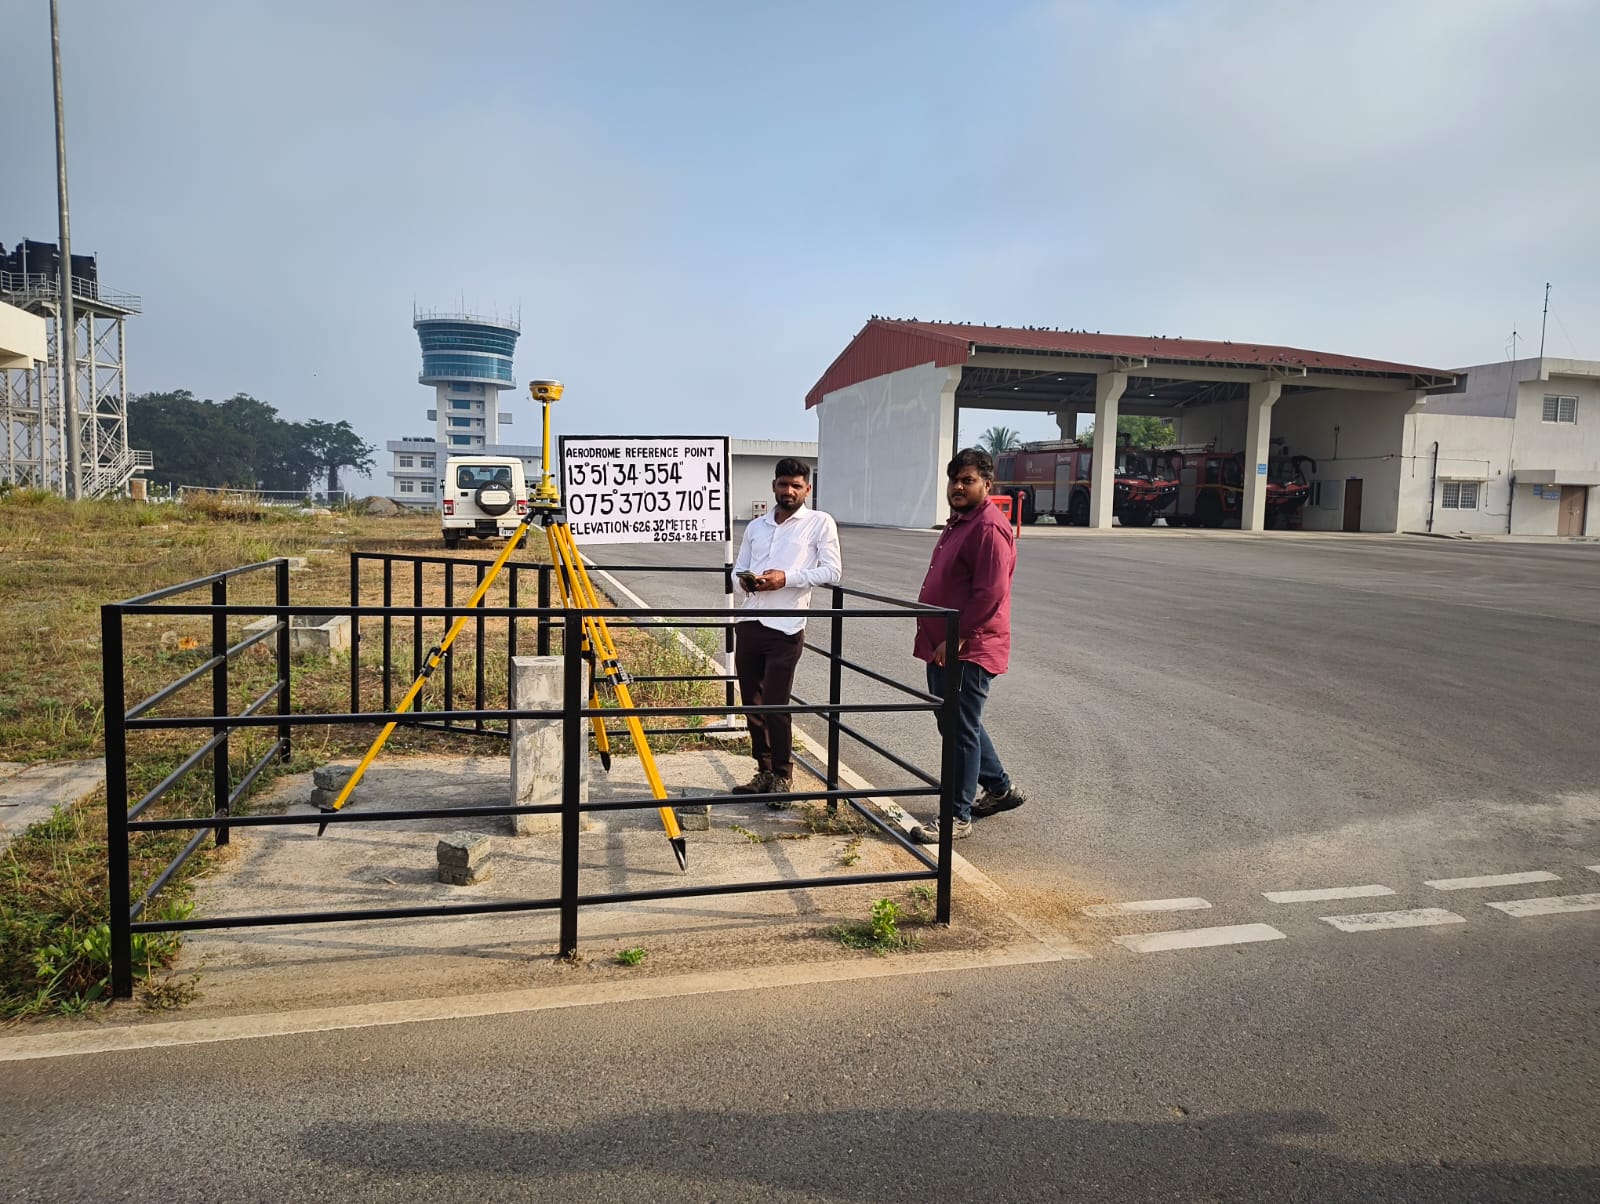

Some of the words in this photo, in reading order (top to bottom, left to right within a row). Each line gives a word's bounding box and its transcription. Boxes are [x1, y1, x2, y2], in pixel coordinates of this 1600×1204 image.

[566, 447, 621, 458] AERODROME
[625, 447, 679, 458] REFERENCE
[684, 447, 715, 457] POINT
[706, 462, 720, 483] N
[700, 530, 724, 541] FEET
